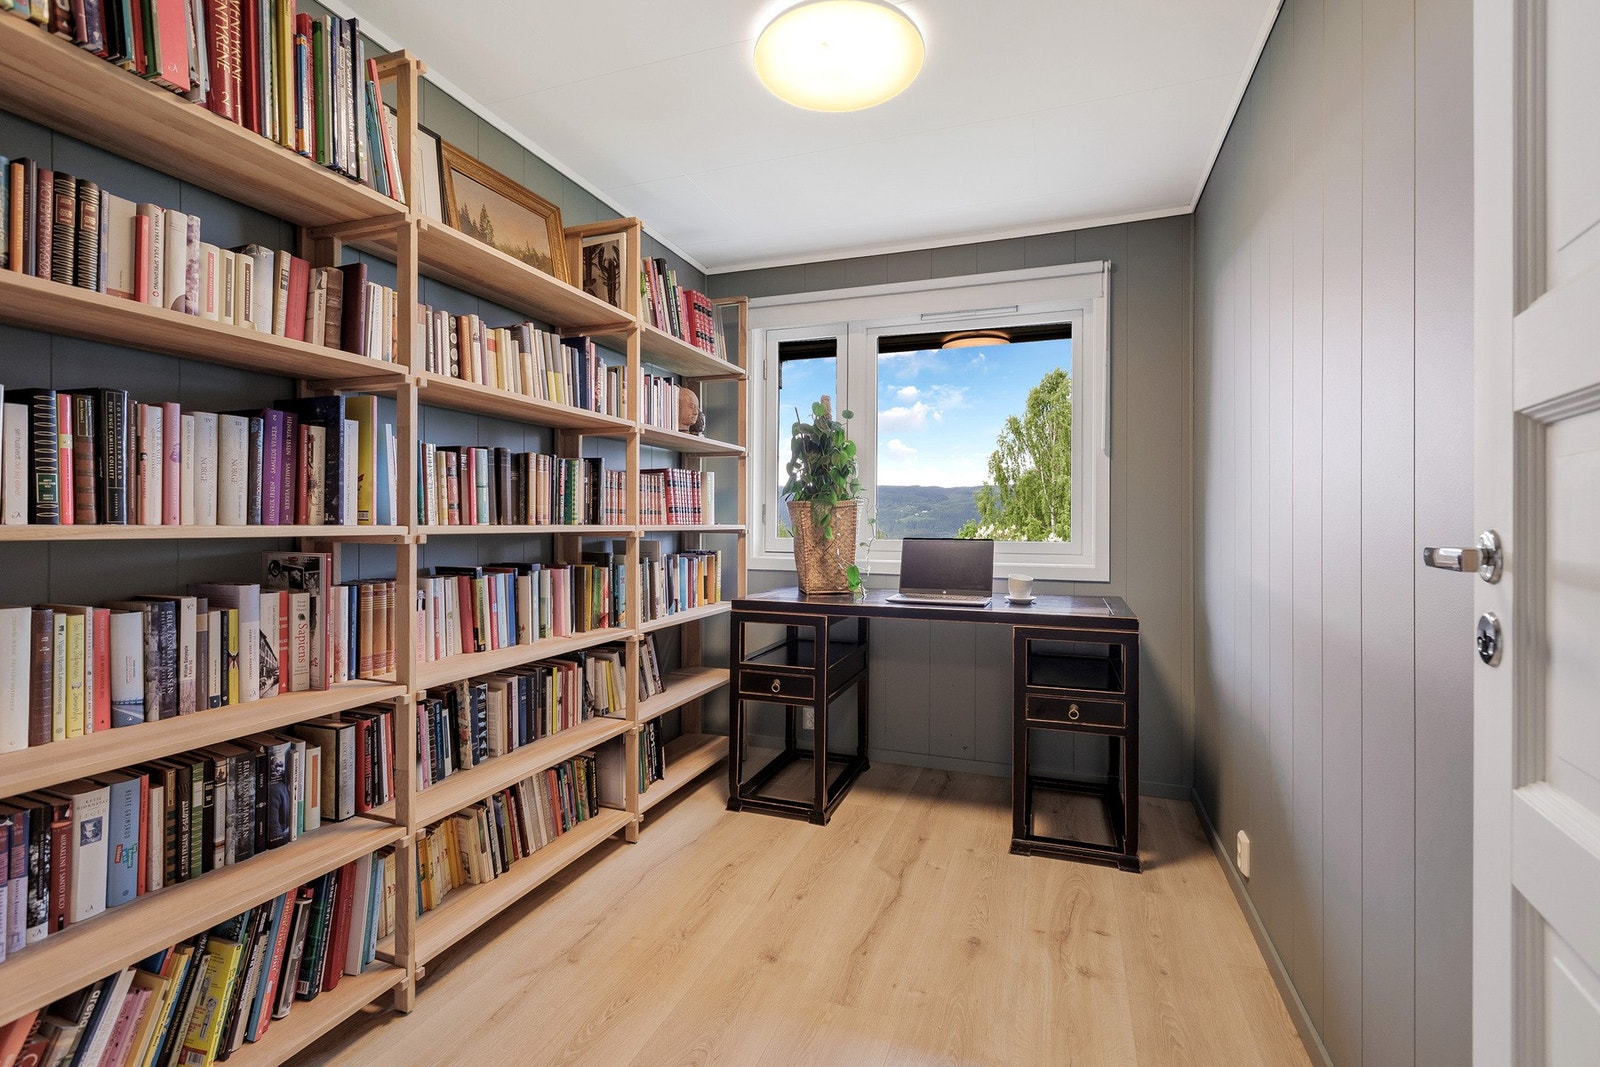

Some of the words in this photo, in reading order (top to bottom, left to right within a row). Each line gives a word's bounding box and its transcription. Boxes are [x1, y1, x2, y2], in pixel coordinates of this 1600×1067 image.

[286, 416, 294, 437] HENRIK
[200, 456, 208, 484] NORGE
[230, 458, 238, 485] NORGE
[268, 499, 276, 522] HENRIK
[57, 640, 65, 655] Vigdis
[294, 622, 309, 664] Sapiens
[124, 789, 133, 808] BEATE
[123, 809, 132, 840] GRIMSRUD
[59, 833, 67, 868] MIRAKLENE
[58, 873, 66, 893] SANTO
[58, 894, 66, 909] FICO
